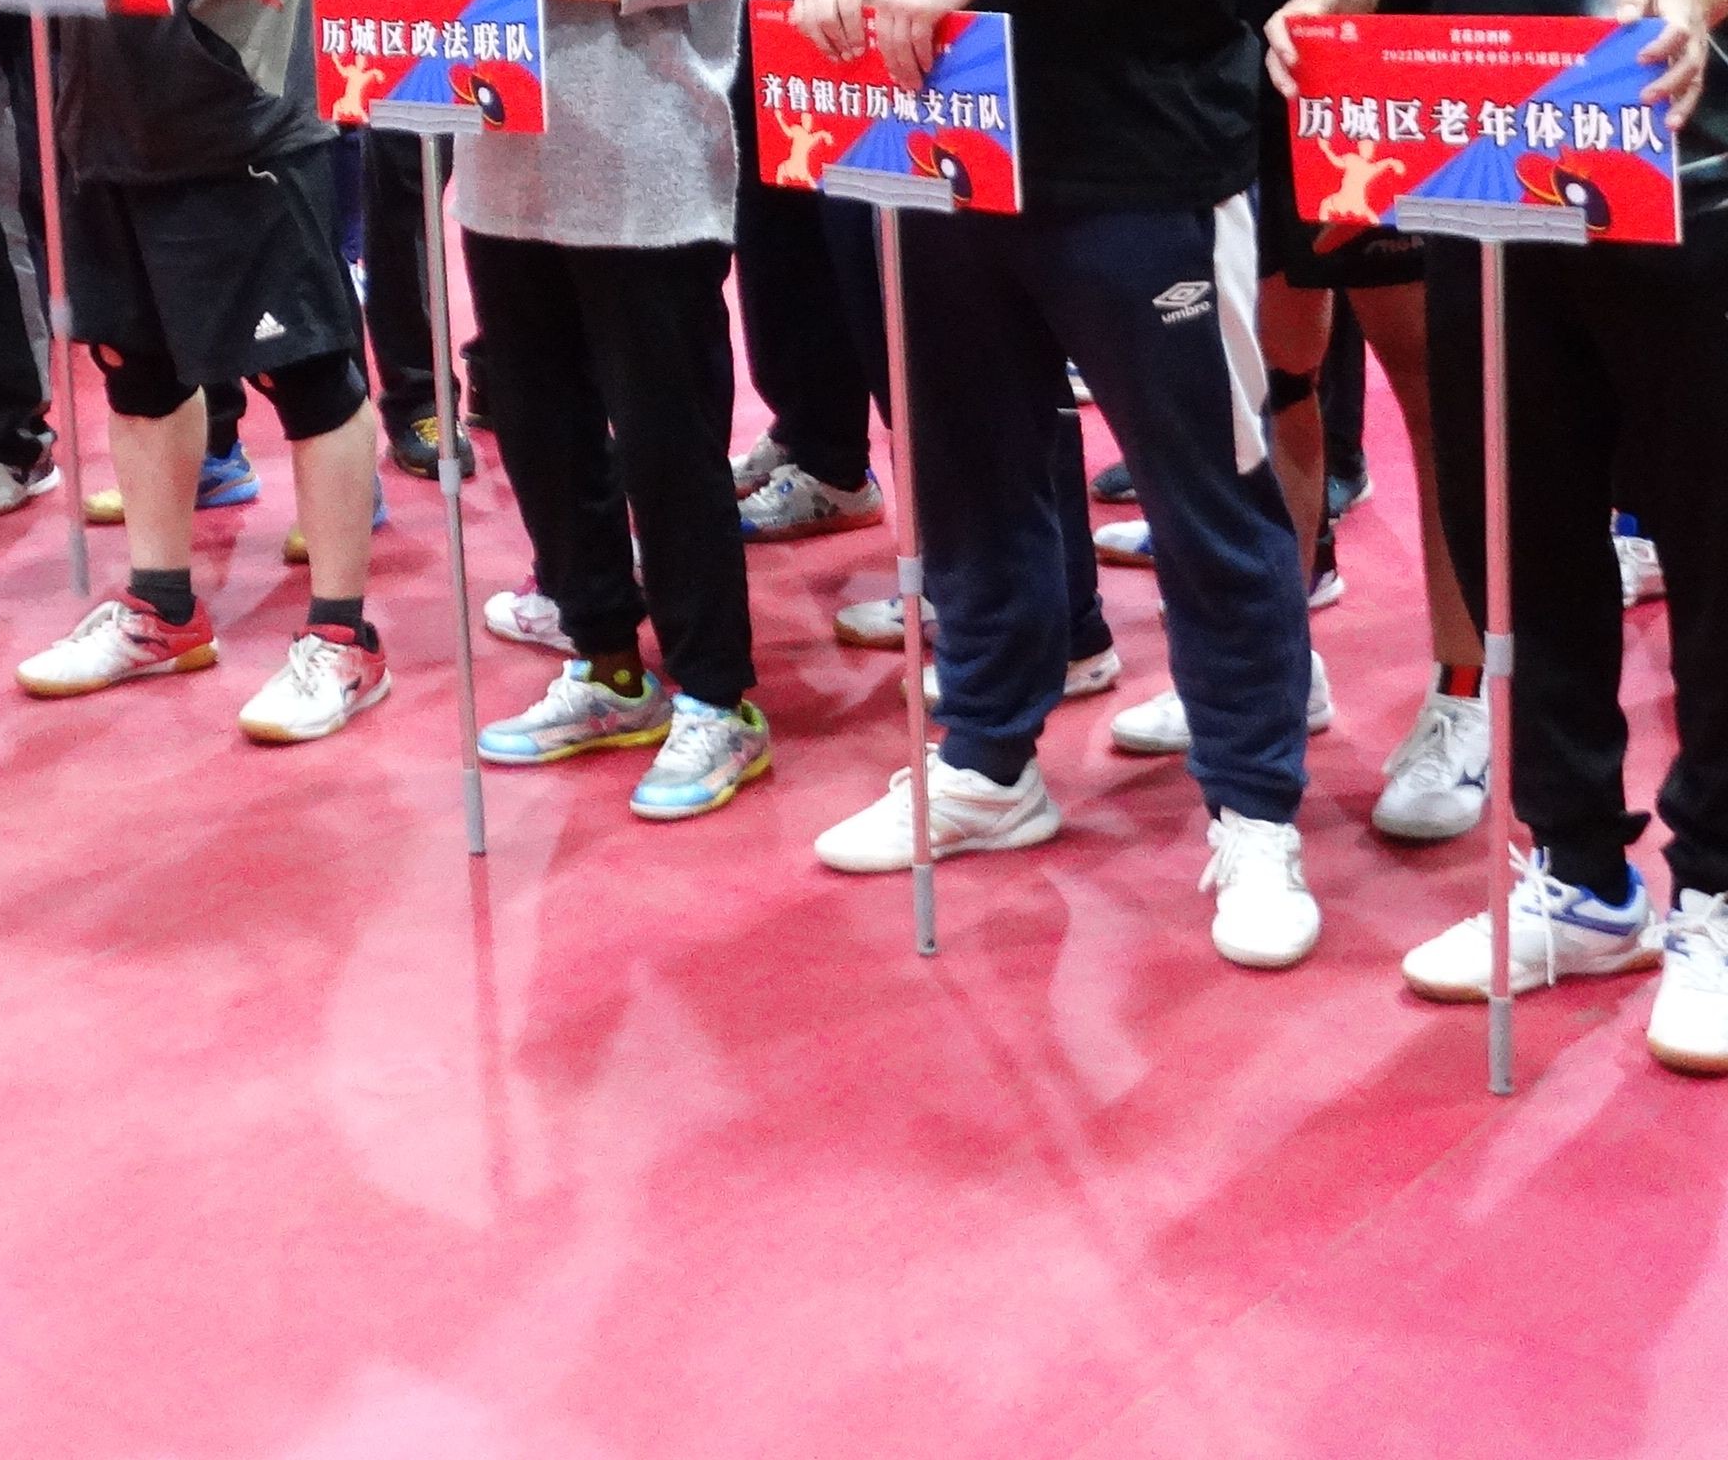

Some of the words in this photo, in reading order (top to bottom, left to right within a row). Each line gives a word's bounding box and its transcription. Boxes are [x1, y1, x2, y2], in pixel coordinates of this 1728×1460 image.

[321, 17, 534, 62] 历城区政法联队
[759, 72, 1007, 131] 齐鲁银行历城支行队
[1297, 95, 1665, 153] 历城区老年体协队
[1160, 300, 1211, 325] umbro
